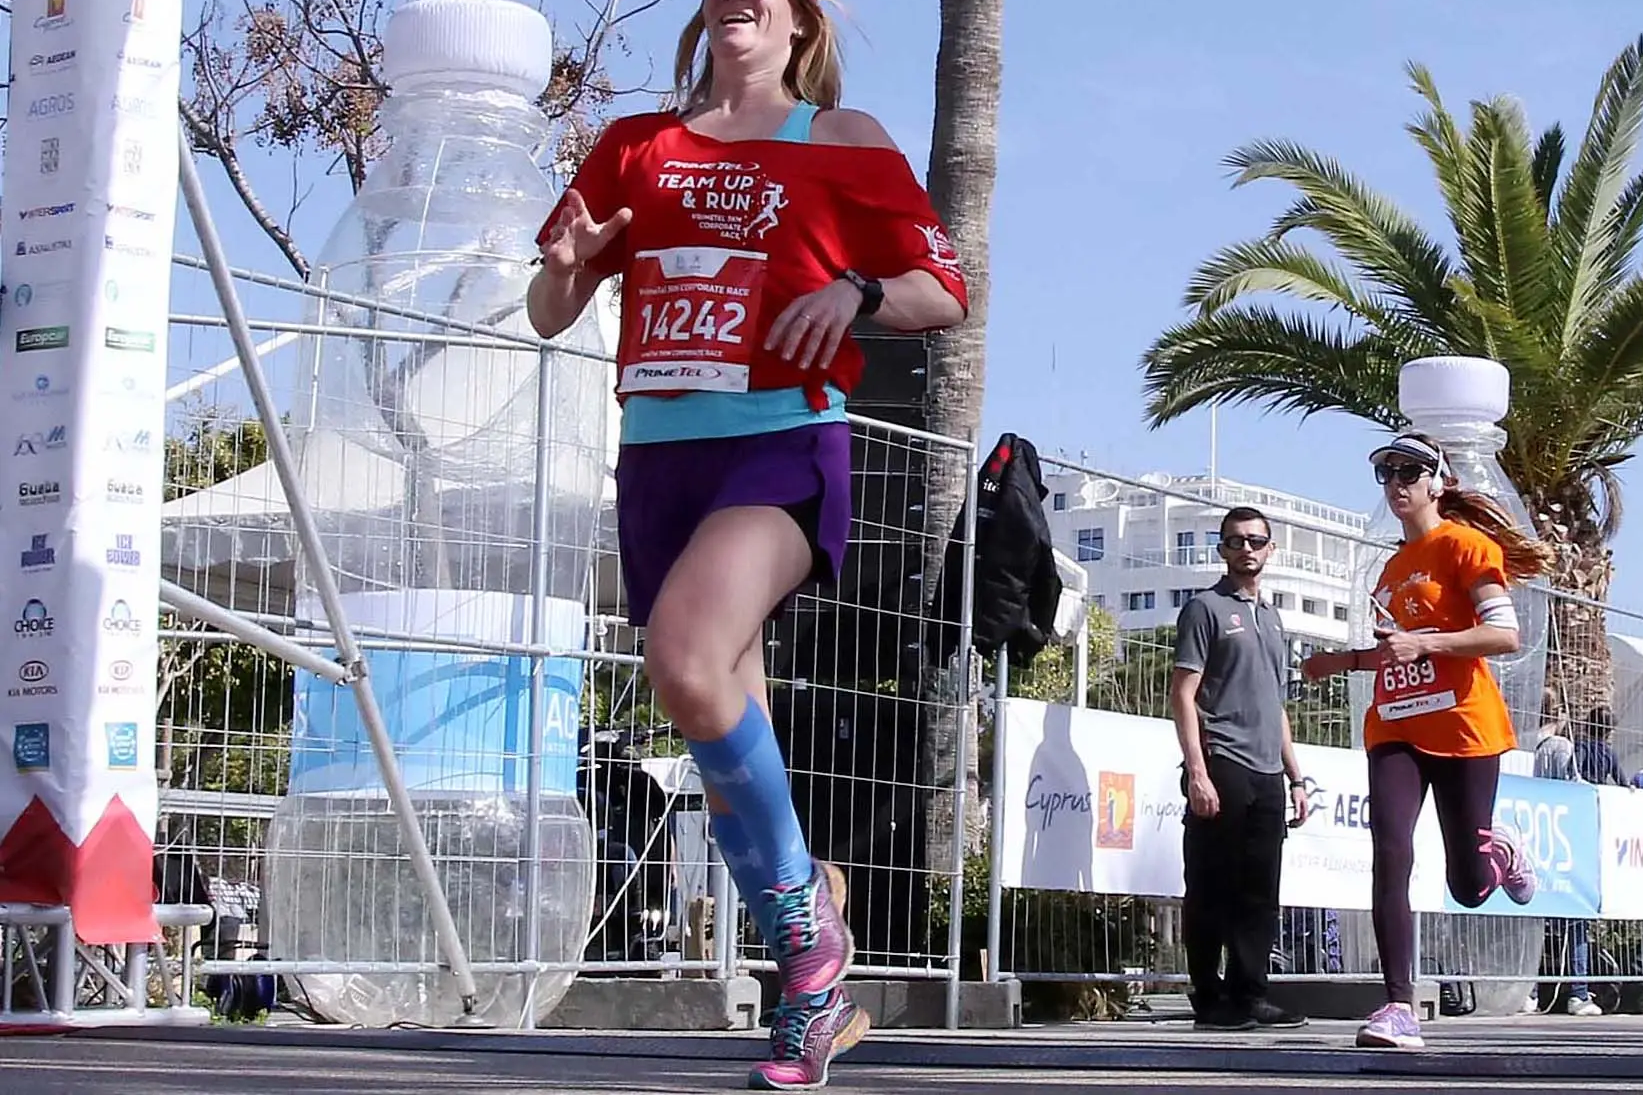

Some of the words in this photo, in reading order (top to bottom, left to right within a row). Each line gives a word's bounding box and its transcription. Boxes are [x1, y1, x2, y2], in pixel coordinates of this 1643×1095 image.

[46, 50, 77, 65] AEGEAN
[28, 92, 76, 117] AGROS
[658, 173, 717, 189] TEAM
[723, 174, 754, 191] UP
[682, 190, 697, 209] &
[705, 191, 752, 211] RUN
[725, 286, 751, 297] RACE
[640, 297, 747, 345] 14242
[14, 617, 54, 633] CHOICE
[103, 617, 141, 632] CHOICE
[22, 665, 44, 679] KIA
[1383, 658, 1436, 692] 6389
[22, 685, 59, 697] MOTORS
[1025, 773, 1092, 831] Cyprus
